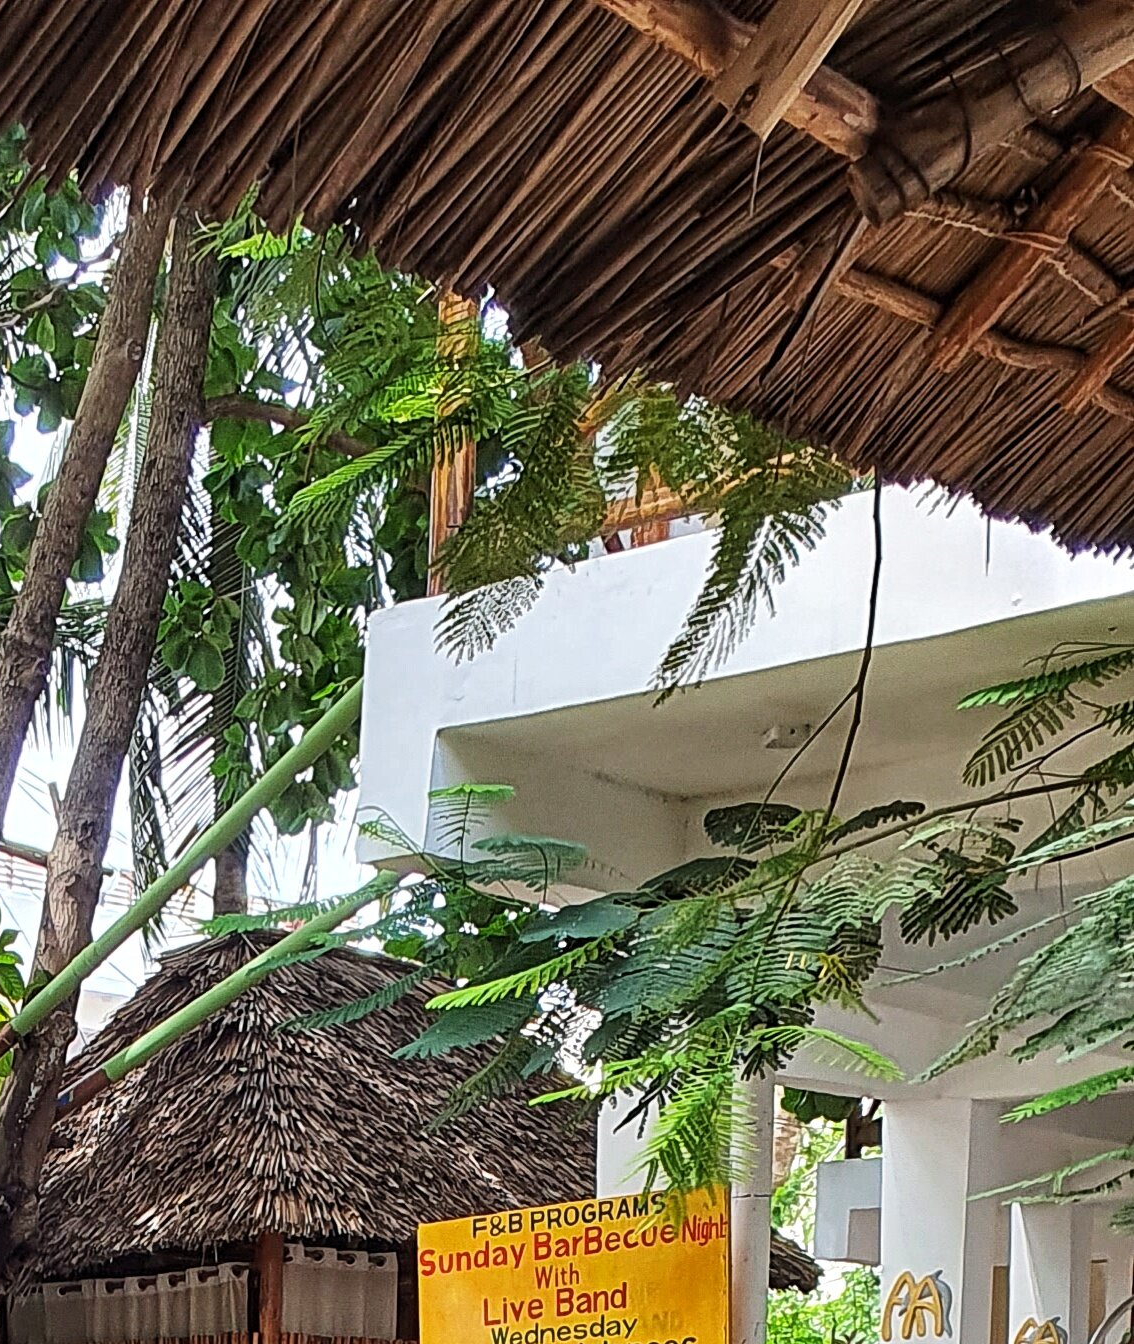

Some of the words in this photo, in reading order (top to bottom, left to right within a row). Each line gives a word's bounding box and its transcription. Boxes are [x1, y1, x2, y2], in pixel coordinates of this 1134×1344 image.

[472, 1212, 524, 1239] F&B
[530, 1193, 667, 1232] PROGRAMS
[419, 1240, 527, 1277] Sunday
[533, 1222, 676, 1262] BarBecue
[681, 1213, 728, 1247] Night
[535, 1263, 580, 1290] With
[482, 1297, 545, 1327] Live
[556, 1282, 628, 1317] Band
